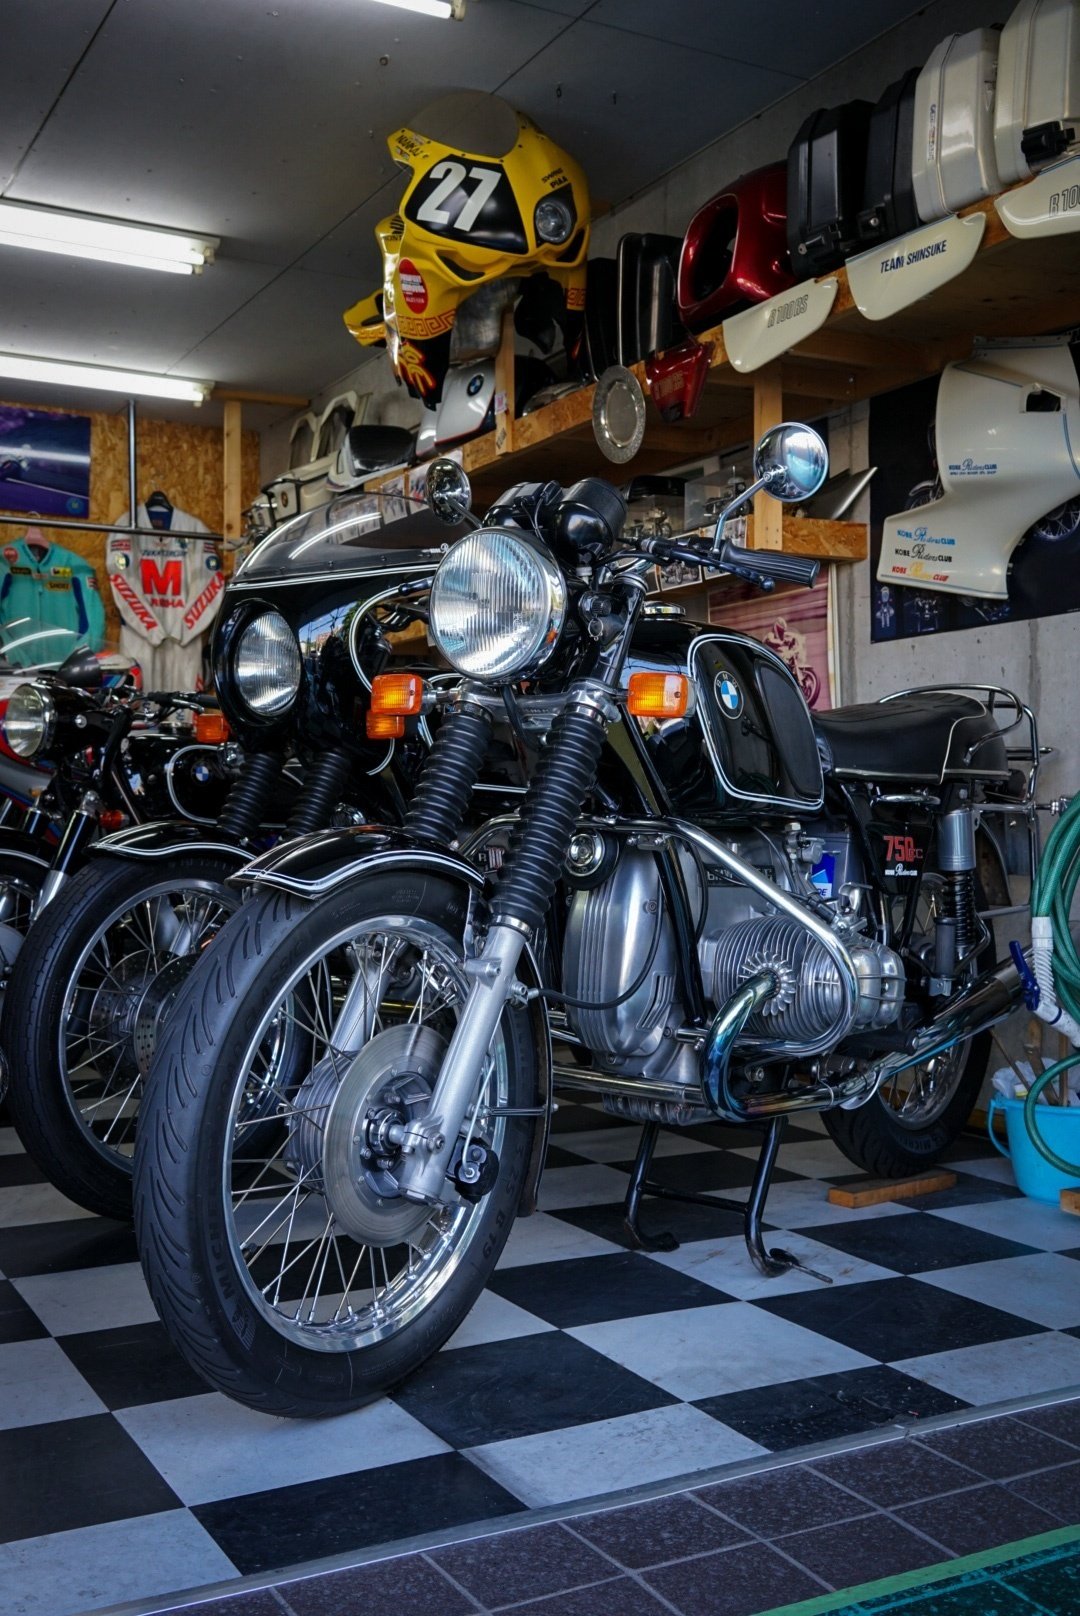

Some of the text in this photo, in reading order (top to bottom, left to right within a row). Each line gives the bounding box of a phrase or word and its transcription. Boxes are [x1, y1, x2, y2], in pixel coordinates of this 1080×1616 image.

[417, 161, 502, 232] 27
[1049, 193, 1060, 217] R
[880, 240, 947, 273] TEAM SHINSUKE
[896, 529, 912, 539] KOBE
[894, 548, 910, 557] KOBE
[938, 555, 952, 563] CLUB
[140, 558, 183, 596] M
[891, 566, 907, 574] KOBE
[933, 574, 949, 582] CLUB
[110, 573, 158, 631] SUZUKA
